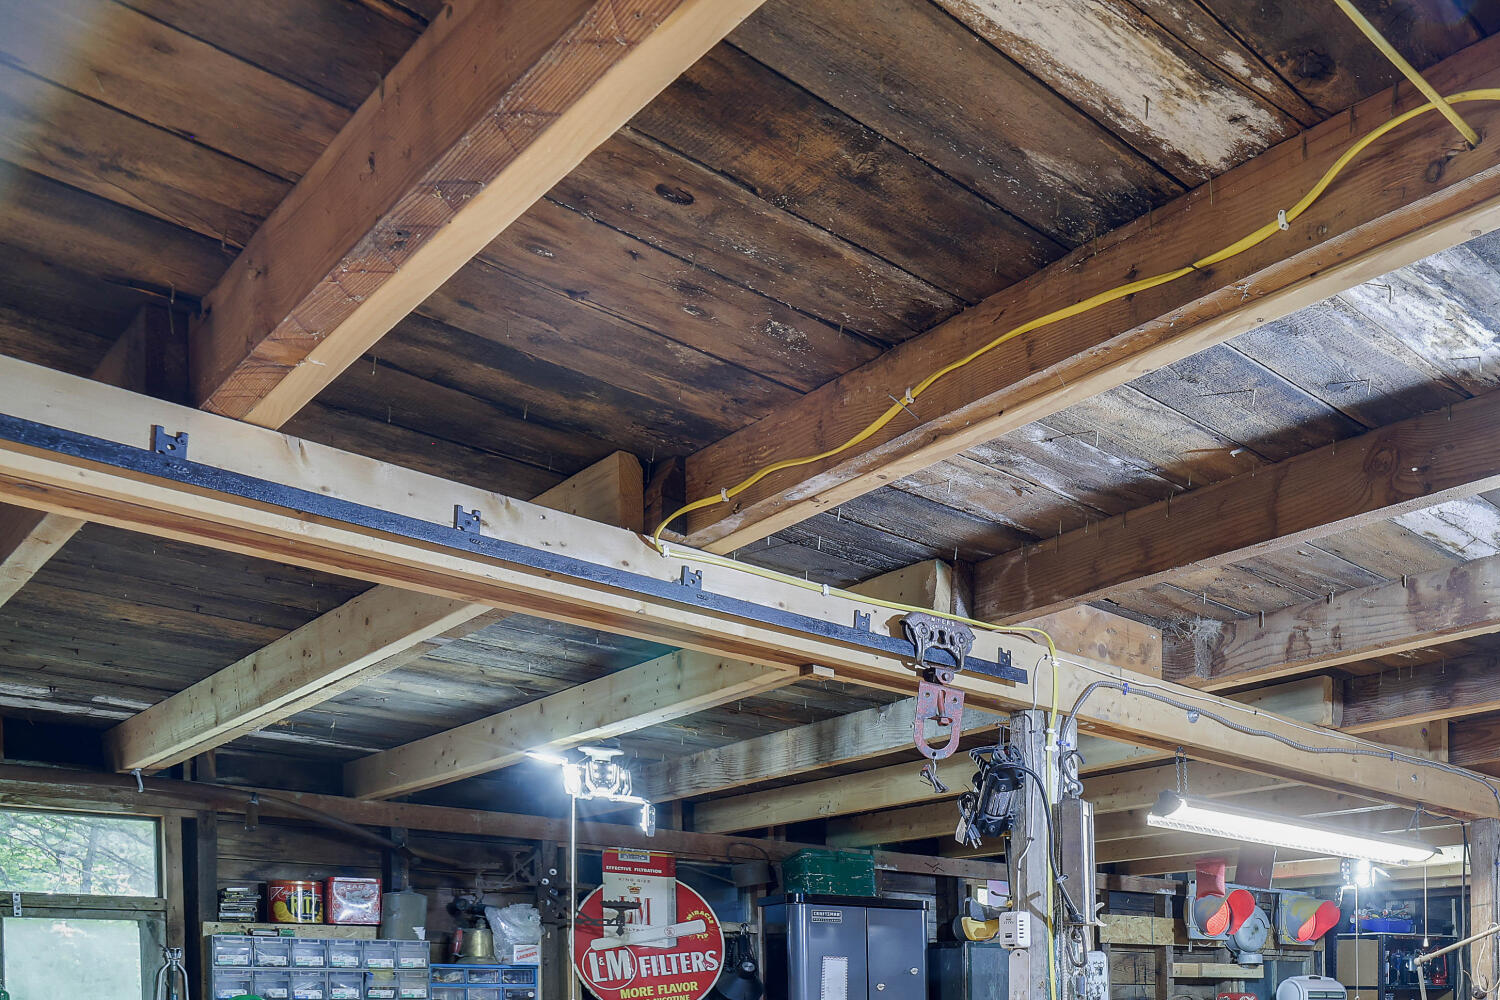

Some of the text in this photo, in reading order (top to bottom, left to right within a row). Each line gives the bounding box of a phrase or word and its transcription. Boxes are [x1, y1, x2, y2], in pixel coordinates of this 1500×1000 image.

[588, 948, 719, 983] L&M FILTERS
[620, 981, 699, 999] MORE FLAVOR
